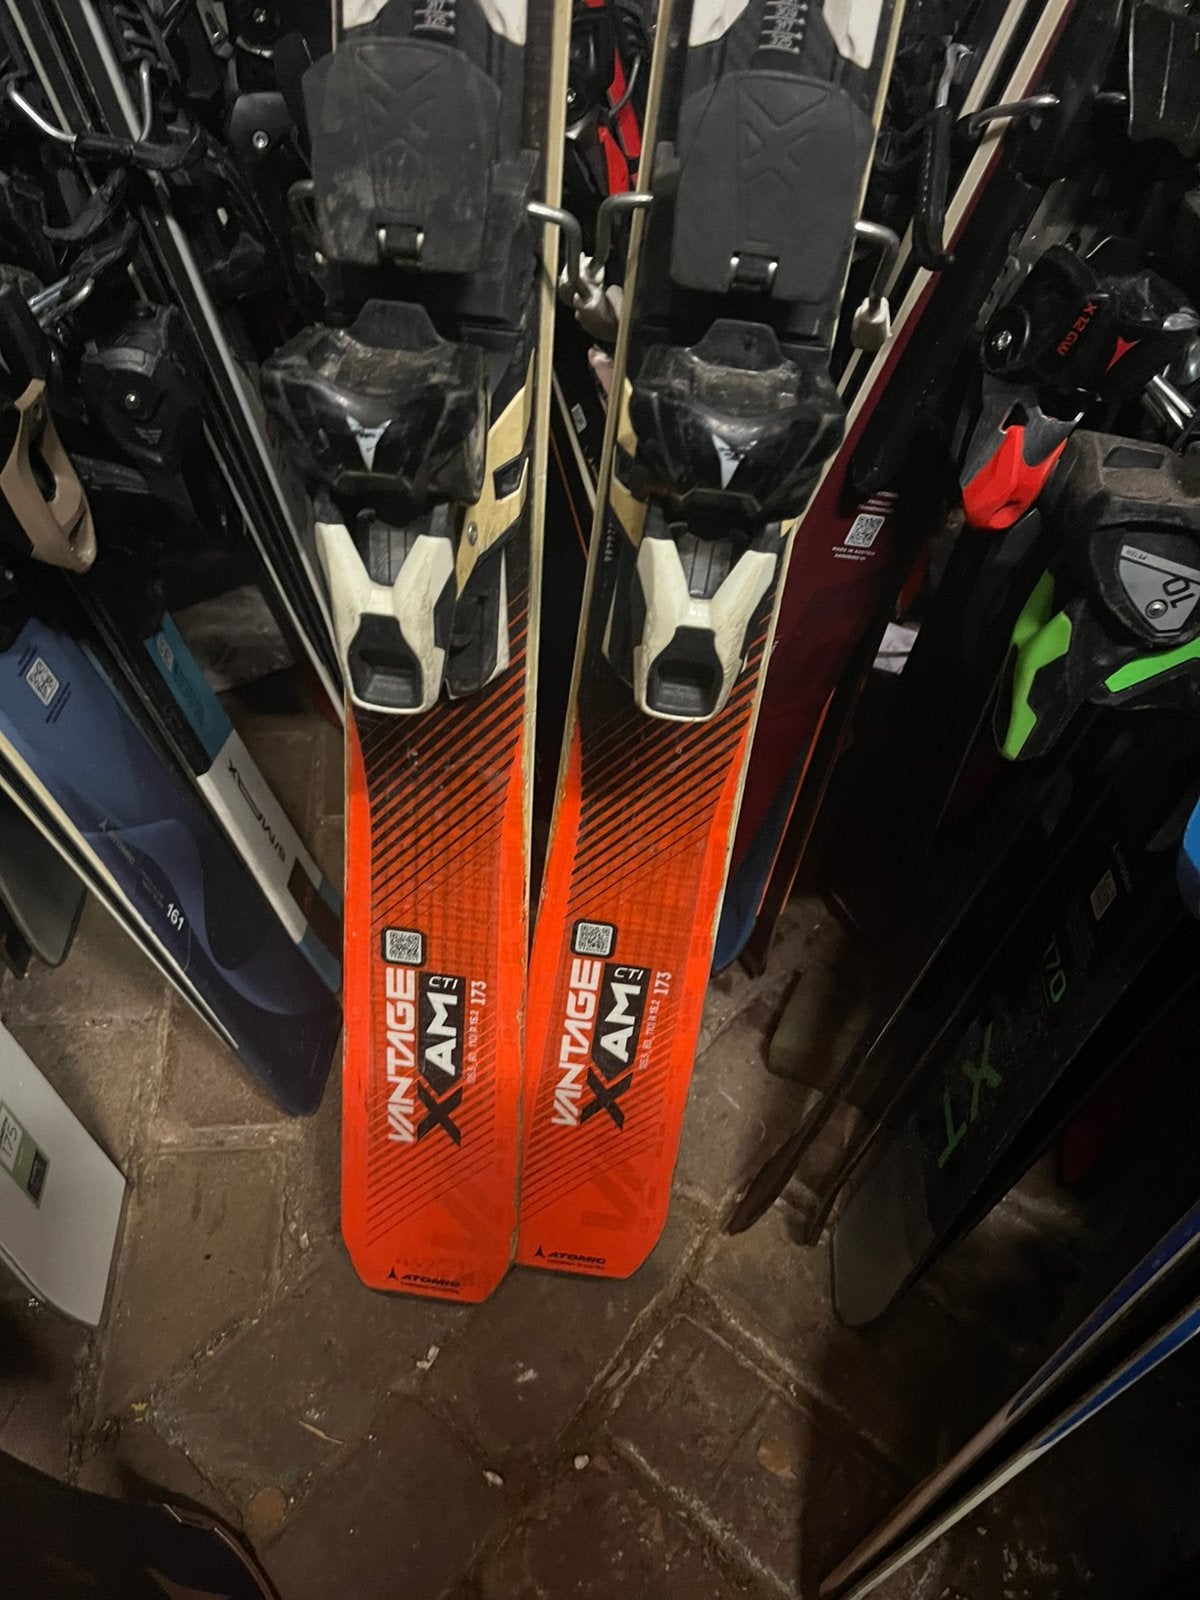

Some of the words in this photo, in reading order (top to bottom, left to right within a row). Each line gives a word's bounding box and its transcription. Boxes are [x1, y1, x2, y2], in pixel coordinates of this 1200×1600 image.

[1083, 301, 1098, 315] X
[1163, 577, 1195, 609] 10
[166, 903, 185, 931] 161
[428, 975, 459, 990] CTI
[614, 967, 645, 981] CTI
[653, 971, 672, 996] 173
[470, 980, 487, 1005] 173
[386, 966, 415, 1143] VANTAGE
[550, 957, 602, 1127] VANTAGE
[1, 1124, 18, 1159] 175
[547, 1251, 607, 1265] ATOMIC
[401, 1274, 460, 1288] ATOMIC
